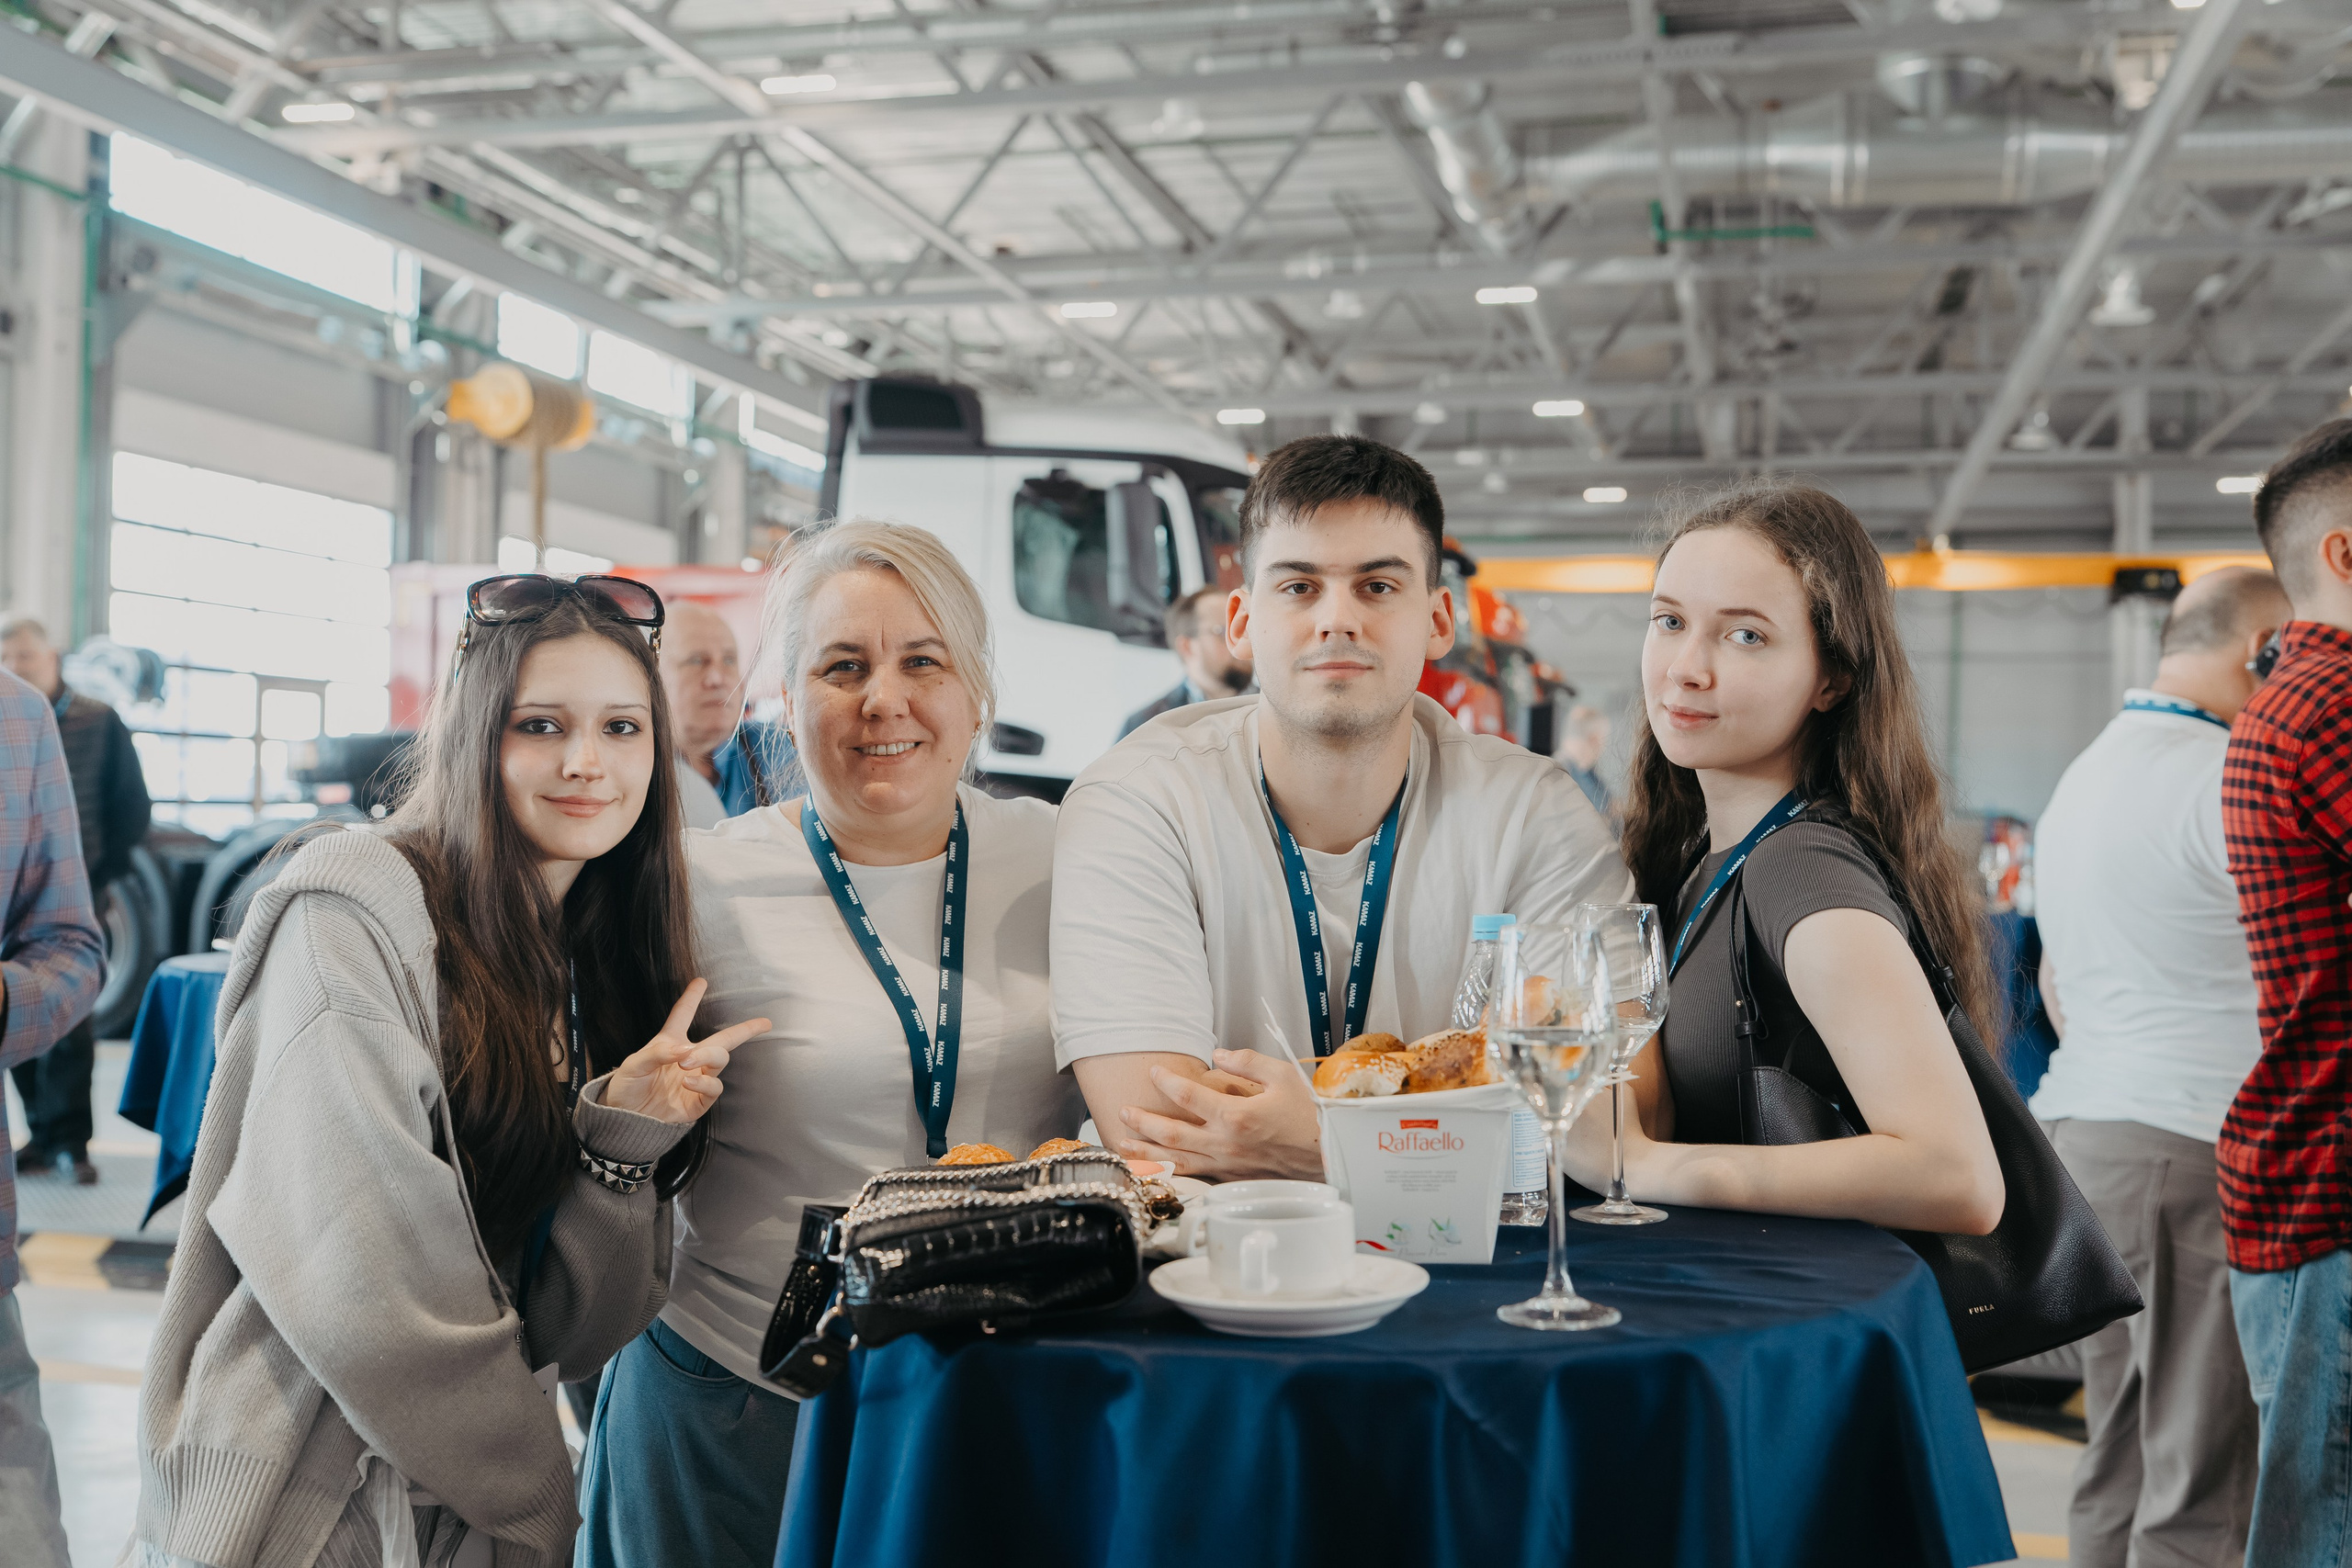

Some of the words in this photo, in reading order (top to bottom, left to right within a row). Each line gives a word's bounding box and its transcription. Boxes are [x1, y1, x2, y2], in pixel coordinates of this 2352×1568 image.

[1787, 798, 1810, 818] KAMAZ
[813, 819, 829, 841] KAMAZ
[829, 851, 844, 874] KAMAZ
[948, 841, 956, 862] KAMAZ
[1365, 861, 1376, 886] KAMAZ
[1727, 853, 1747, 876] KAMAZ
[844, 883, 860, 905] KAMAZ
[946, 873, 955, 894] KAMAZ
[1299, 870, 1311, 896] KAMAZ
[860, 915, 876, 935] KAMAZ
[944, 904, 953, 925] KAMAZ
[1307, 909, 1318, 936] KAMAZ
[1359, 900, 1370, 927] KAMAZ
[876, 946, 893, 966] KAMAZ
[942, 936, 951, 957] KAMAZ
[1352, 942, 1363, 967] KAMAZ
[1312, 950, 1323, 976] KAMAZ
[894, 976, 910, 997] KAMAZ
[940, 969, 949, 990] KAMAZ
[1317, 990, 1328, 1016] KAMAZ
[1347, 982, 1357, 1009] KAMAZ
[910, 1008, 925, 1032] KAMAZ
[939, 1003, 947, 1026] KAMAZ
[923, 1046, 933, 1073] KAMAZ
[935, 1040, 945, 1066] KAMAZ
[932, 1081, 942, 1108] KAMAZ
[1378, 1131, 1464, 1154] Raffaello
[1968, 1303, 1995, 1315] FURLA
